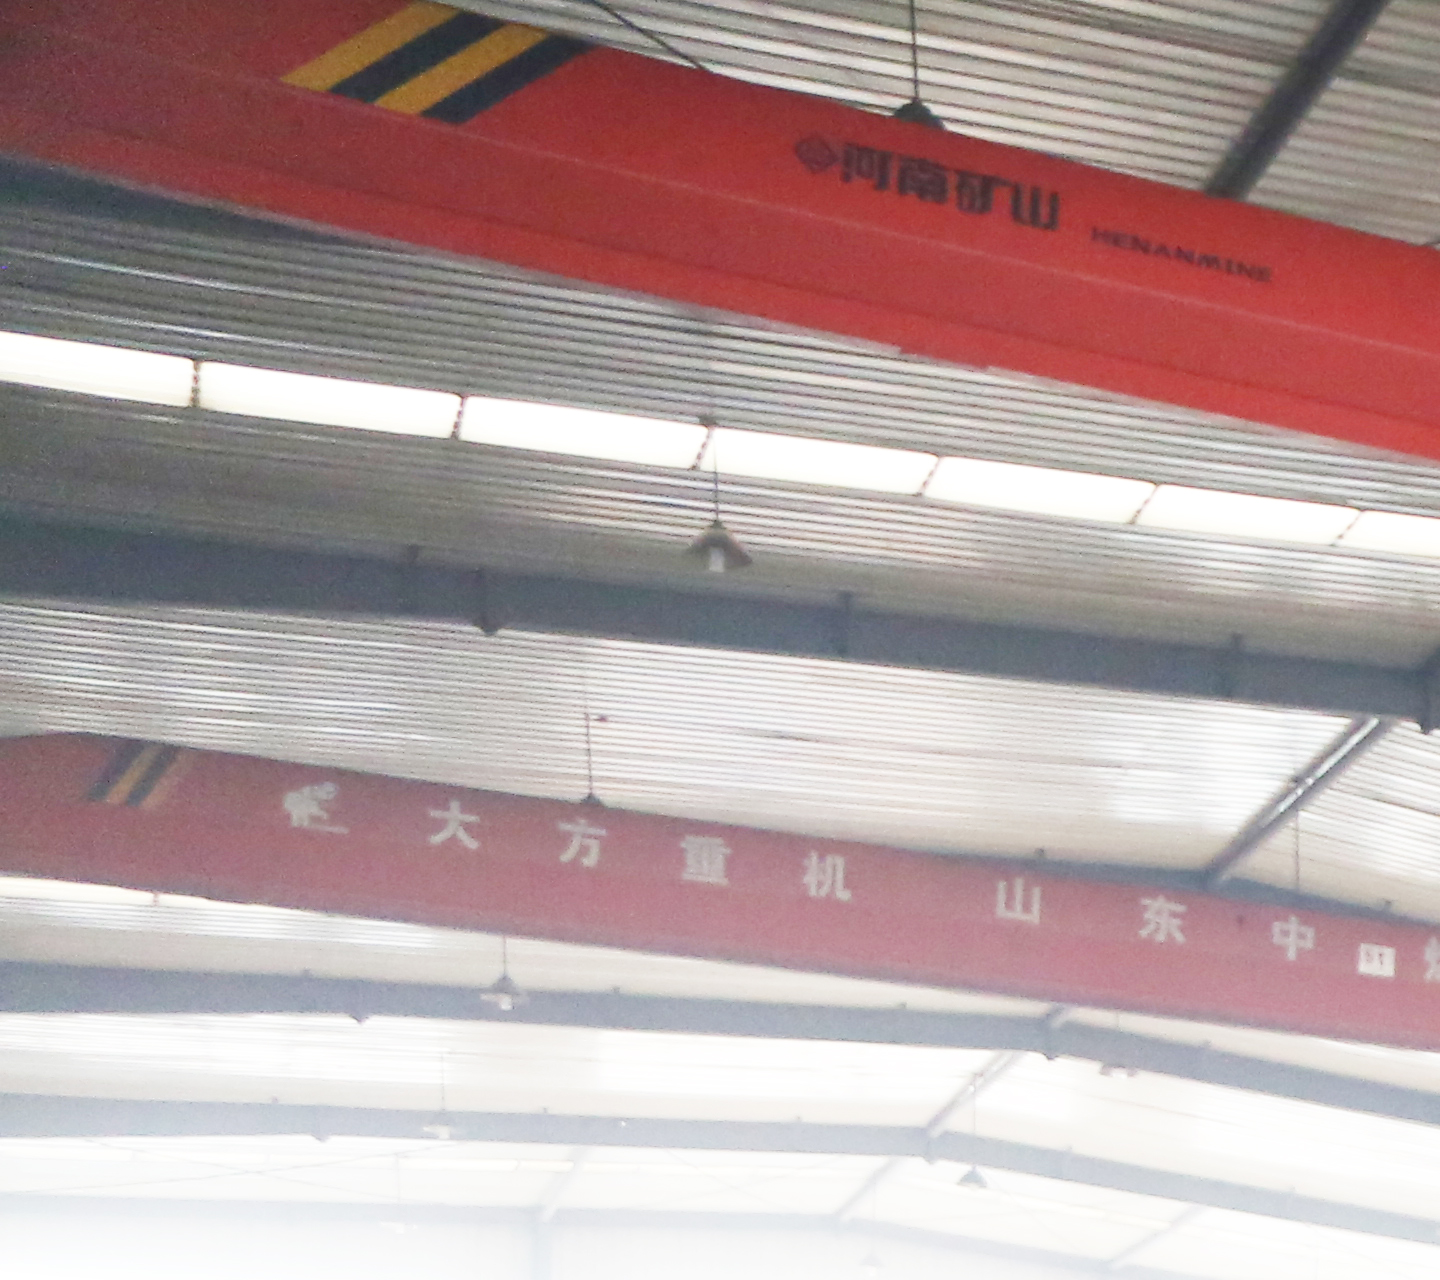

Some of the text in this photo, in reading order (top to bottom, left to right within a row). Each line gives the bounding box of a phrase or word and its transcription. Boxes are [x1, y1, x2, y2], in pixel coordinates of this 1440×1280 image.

[841, 142, 1061, 232] 河南矿山
[429, 801, 853, 901] 大方重机
